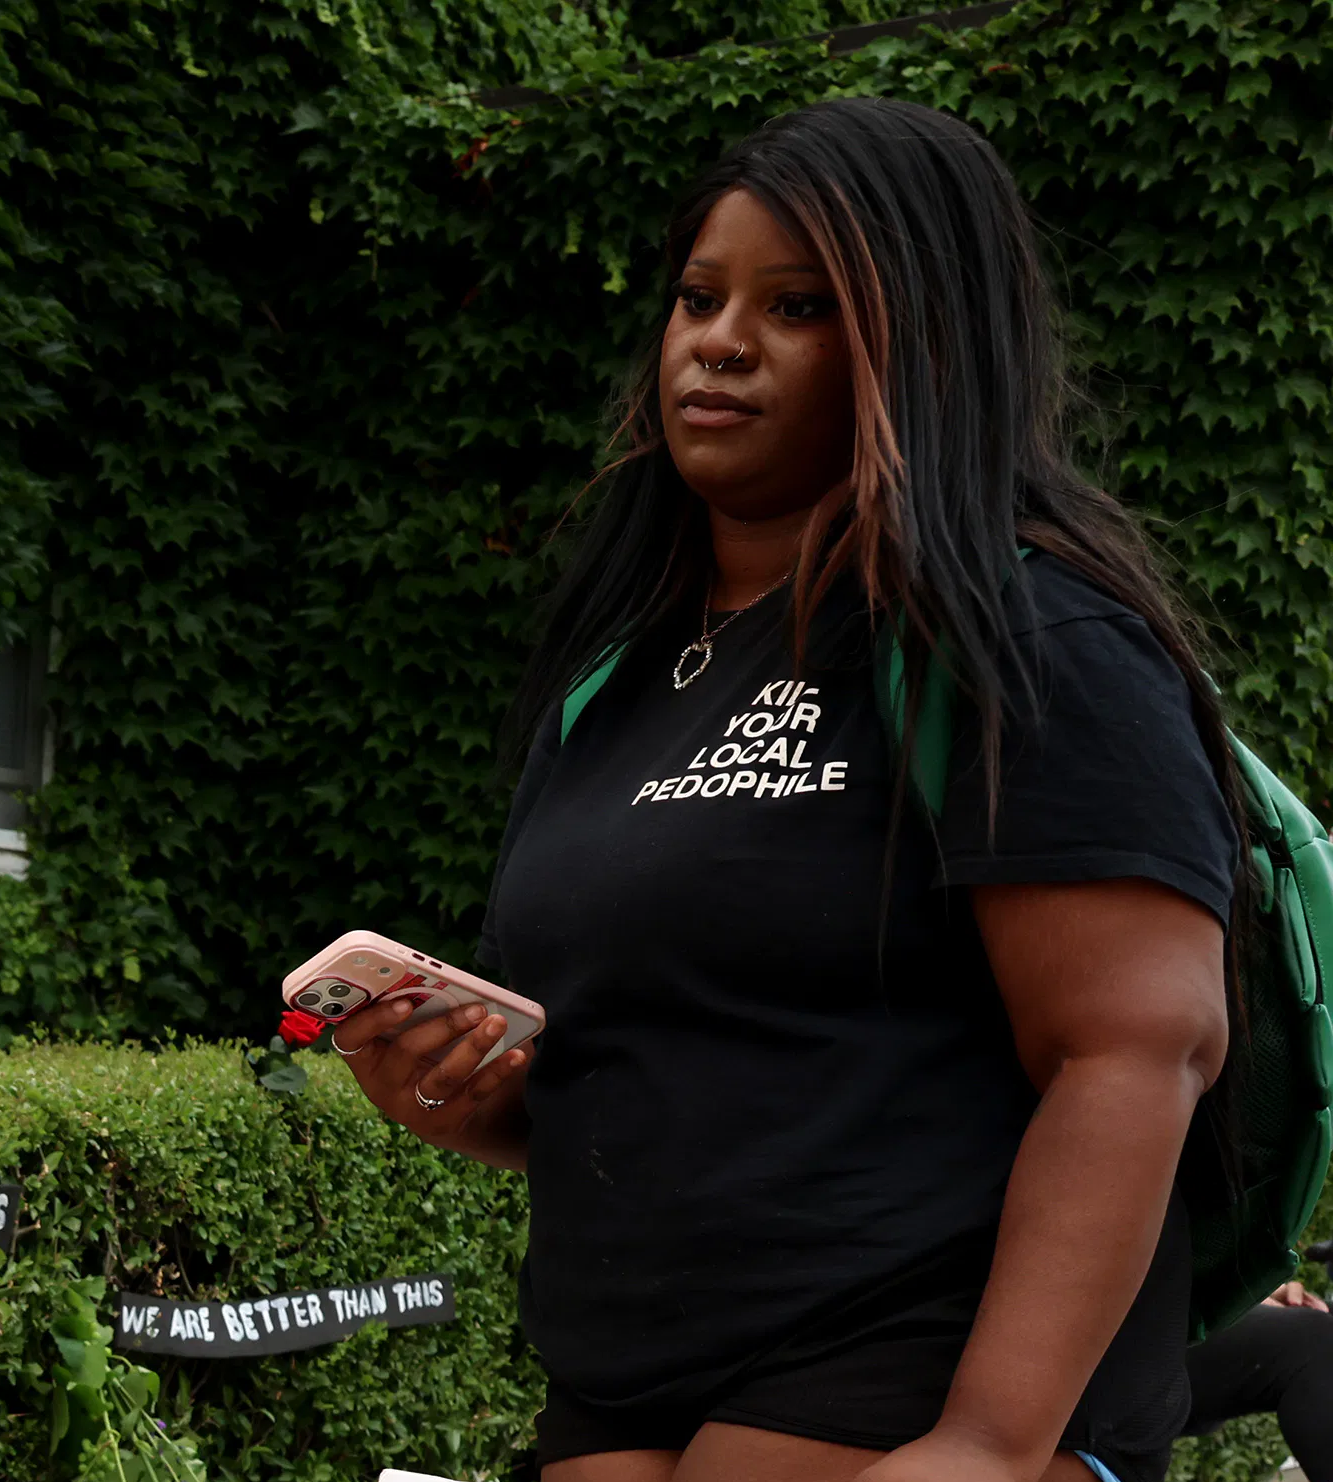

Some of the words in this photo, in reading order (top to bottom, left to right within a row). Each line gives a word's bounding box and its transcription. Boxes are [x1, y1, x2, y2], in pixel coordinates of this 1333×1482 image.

[724, 702, 821, 737] YOUR
[688, 737, 812, 769] LOCAL
[631, 762, 848, 805] PEDOPHILE
[121, 1303, 161, 1338] WE
[170, 1306, 215, 1342] ARE
[221, 1290, 325, 1344] BETTER
[329, 1282, 387, 1321] THAN
[392, 1278, 445, 1313] THIS
